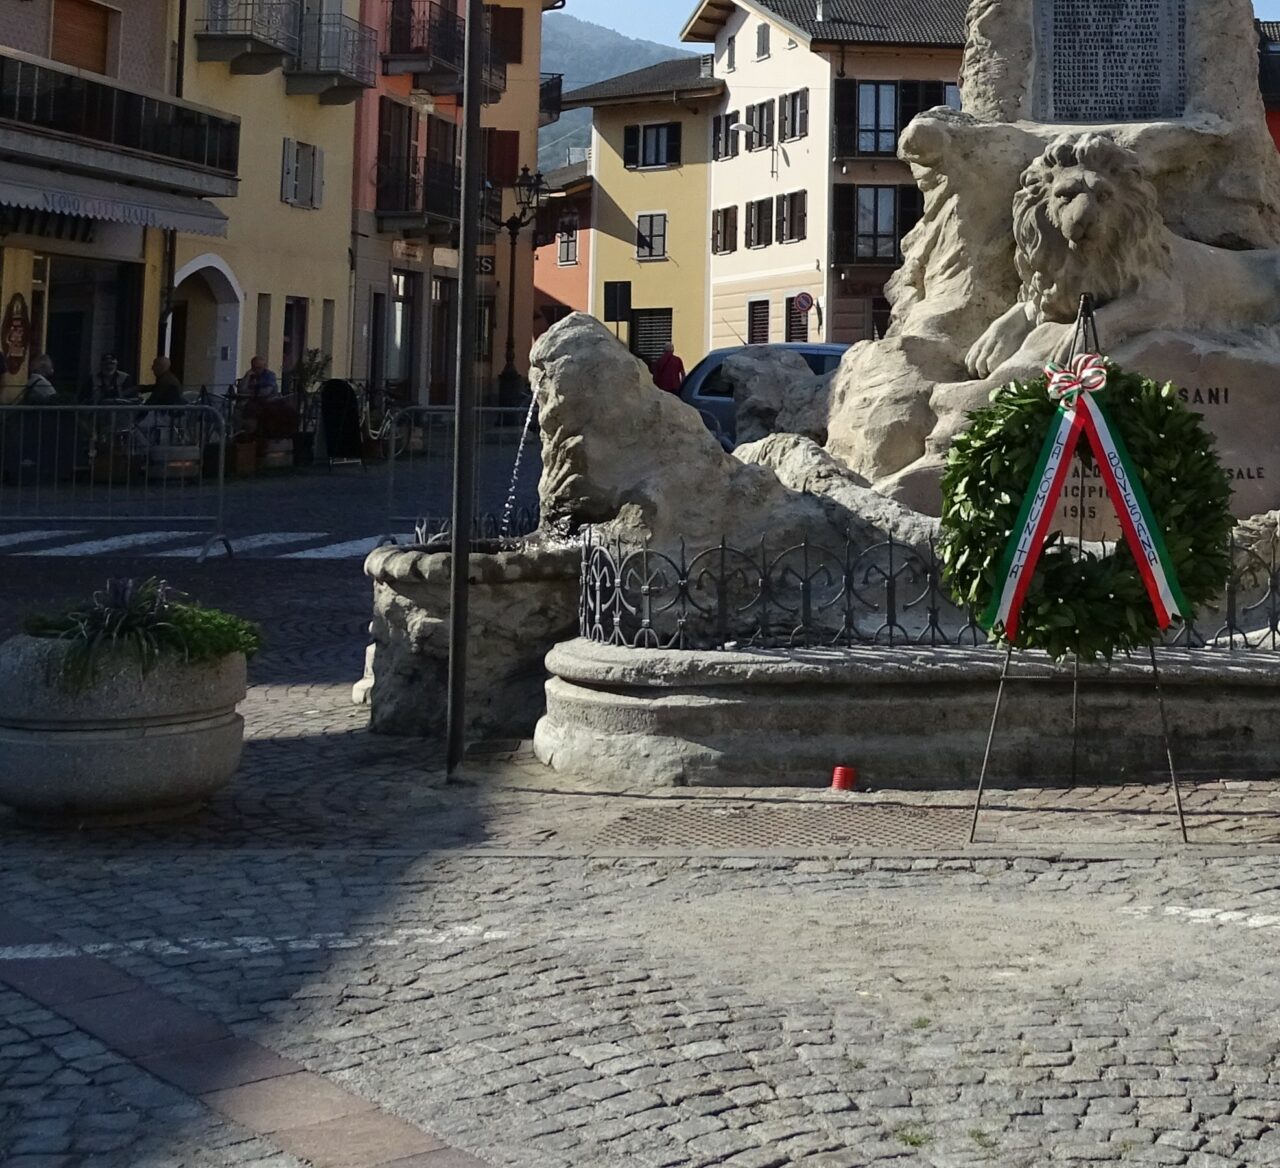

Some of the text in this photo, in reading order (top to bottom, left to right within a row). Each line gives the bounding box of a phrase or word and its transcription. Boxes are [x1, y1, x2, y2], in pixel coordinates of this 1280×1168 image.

[42, 192, 80, 212] NUOVO
[1178, 387, 1229, 405] SANI
[1051, 431, 1065, 460] LA
[1226, 467, 1265, 480] SALE
[1107, 451, 1159, 567] BOVESANA
